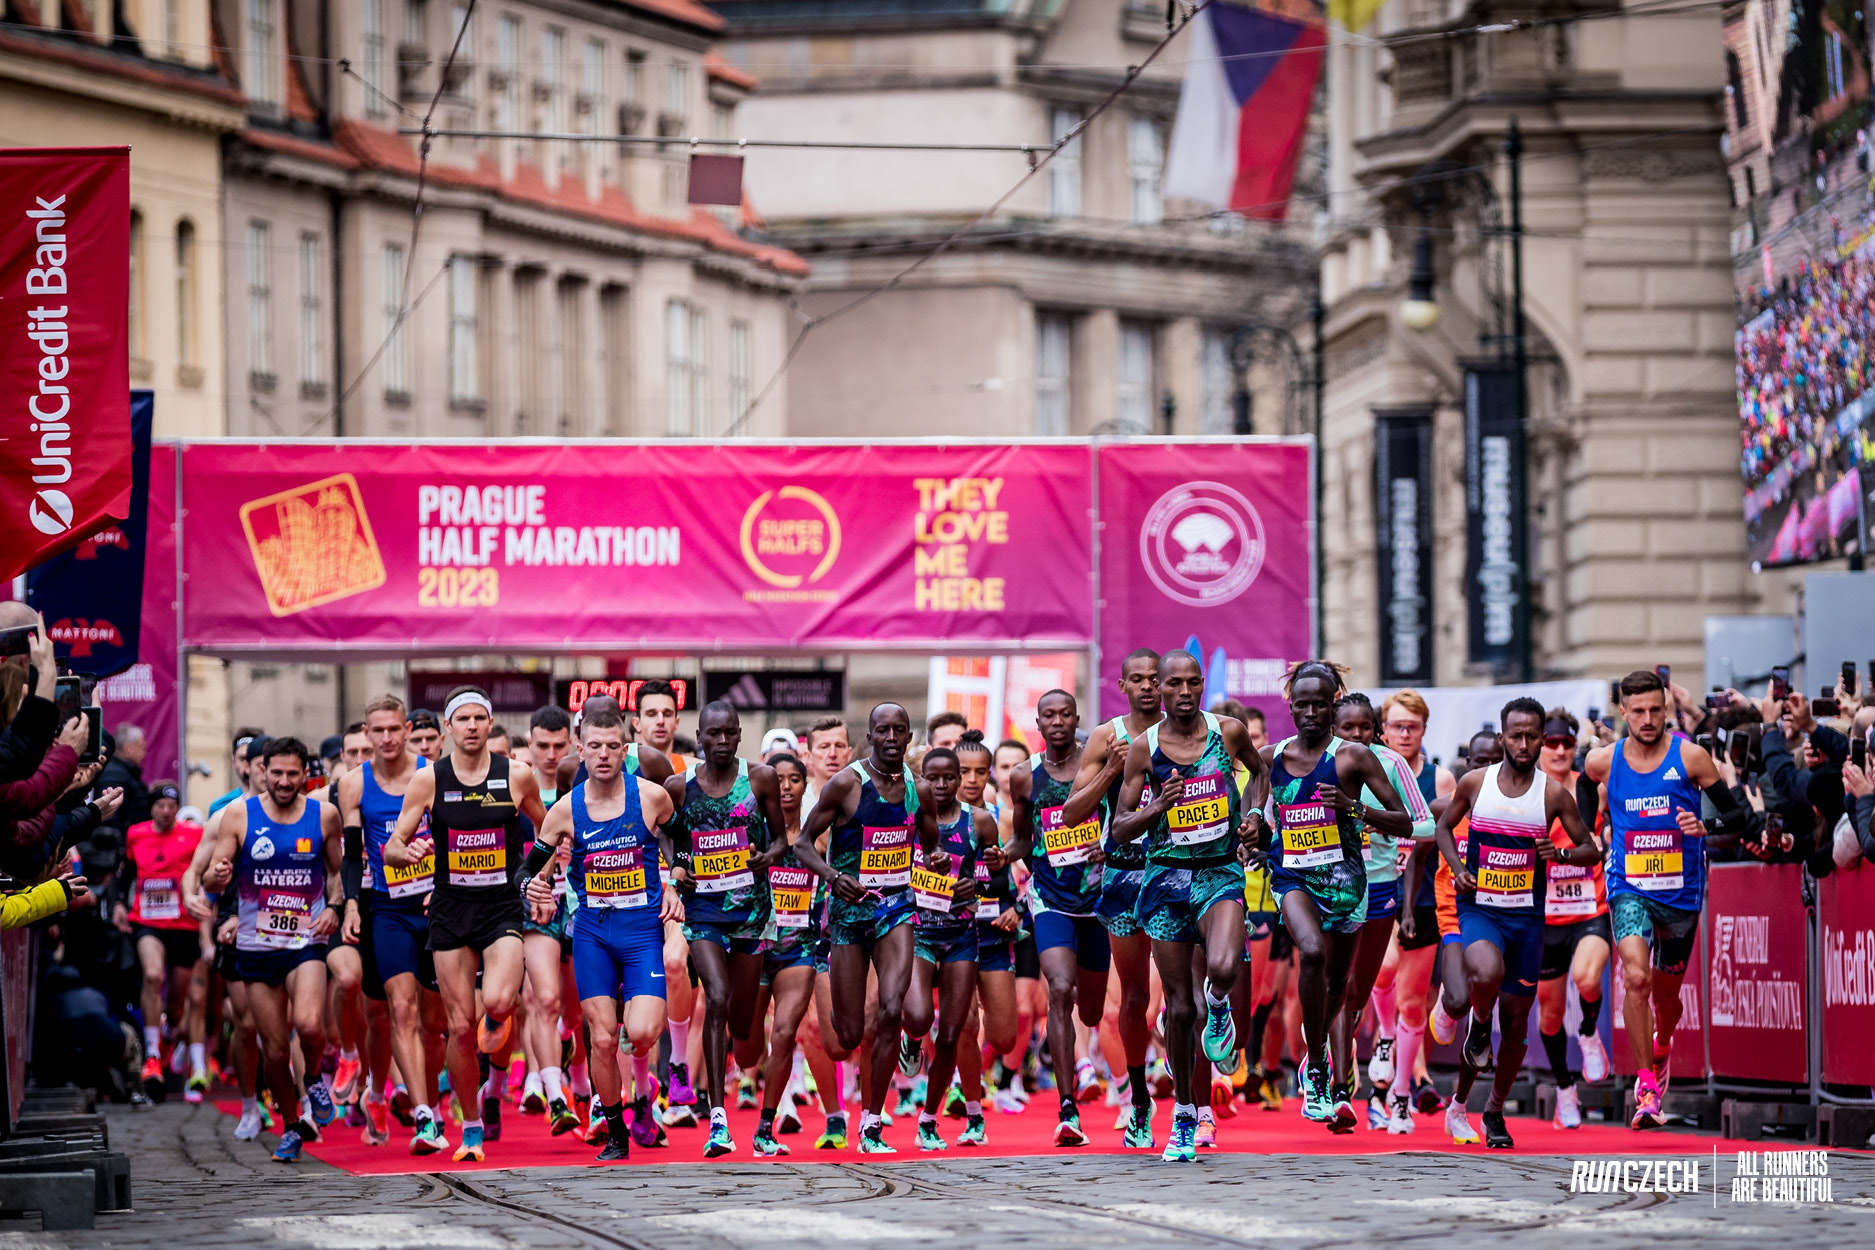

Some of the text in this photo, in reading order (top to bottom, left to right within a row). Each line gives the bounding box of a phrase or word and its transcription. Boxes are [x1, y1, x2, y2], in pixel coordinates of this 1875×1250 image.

[26, 194, 72, 484] UniCredit Bank
[913, 478, 1005, 511] THEY
[418, 485, 546, 525] PRAGUE
[758, 519, 824, 538] SUPER
[914, 511, 1009, 544] LOVE
[418, 526, 681, 566] HALF MARATHON
[757, 536, 824, 555] HALFS
[914, 544, 968, 577] ME
[418, 567, 500, 607] 2023
[914, 577, 1005, 611] HERE
[51, 627, 115, 641] MATTONI
[1184, 779, 1217, 799] ECHIA
[1177, 803, 1220, 825] PACE 3
[1285, 806, 1326, 823] CZECHIA
[456, 832, 497, 847] CZECHIA
[587, 835, 637, 850] AERONAUTICA
[698, 832, 738, 849] CZECHIA
[871, 829, 908, 844] CZECHIA
[1046, 824, 1099, 848] GEOFFREY
[1290, 831, 1320, 848] PACE
[1633, 834, 1673, 849] CZECHIA
[458, 854, 496, 869] MARIO
[592, 851, 634, 868] CZECHIA
[702, 854, 741, 873] PACE 2
[1487, 851, 1528, 866] CZECHIA
[1644, 854, 1664, 873] JIŘÍ
[393, 859, 432, 880] PATRIK
[770, 870, 809, 886] CZECHIA
[1549, 865, 1586, 879] CZECHIA
[253, 874, 312, 886] LATERZA
[590, 873, 641, 891] MICHELE
[911, 871, 948, 893] ANETH
[1484, 872, 1526, 889] PAULOS
[1556, 883, 1583, 898] 548
[267, 893, 306, 910] CZECHIA
[269, 913, 299, 931] 386
